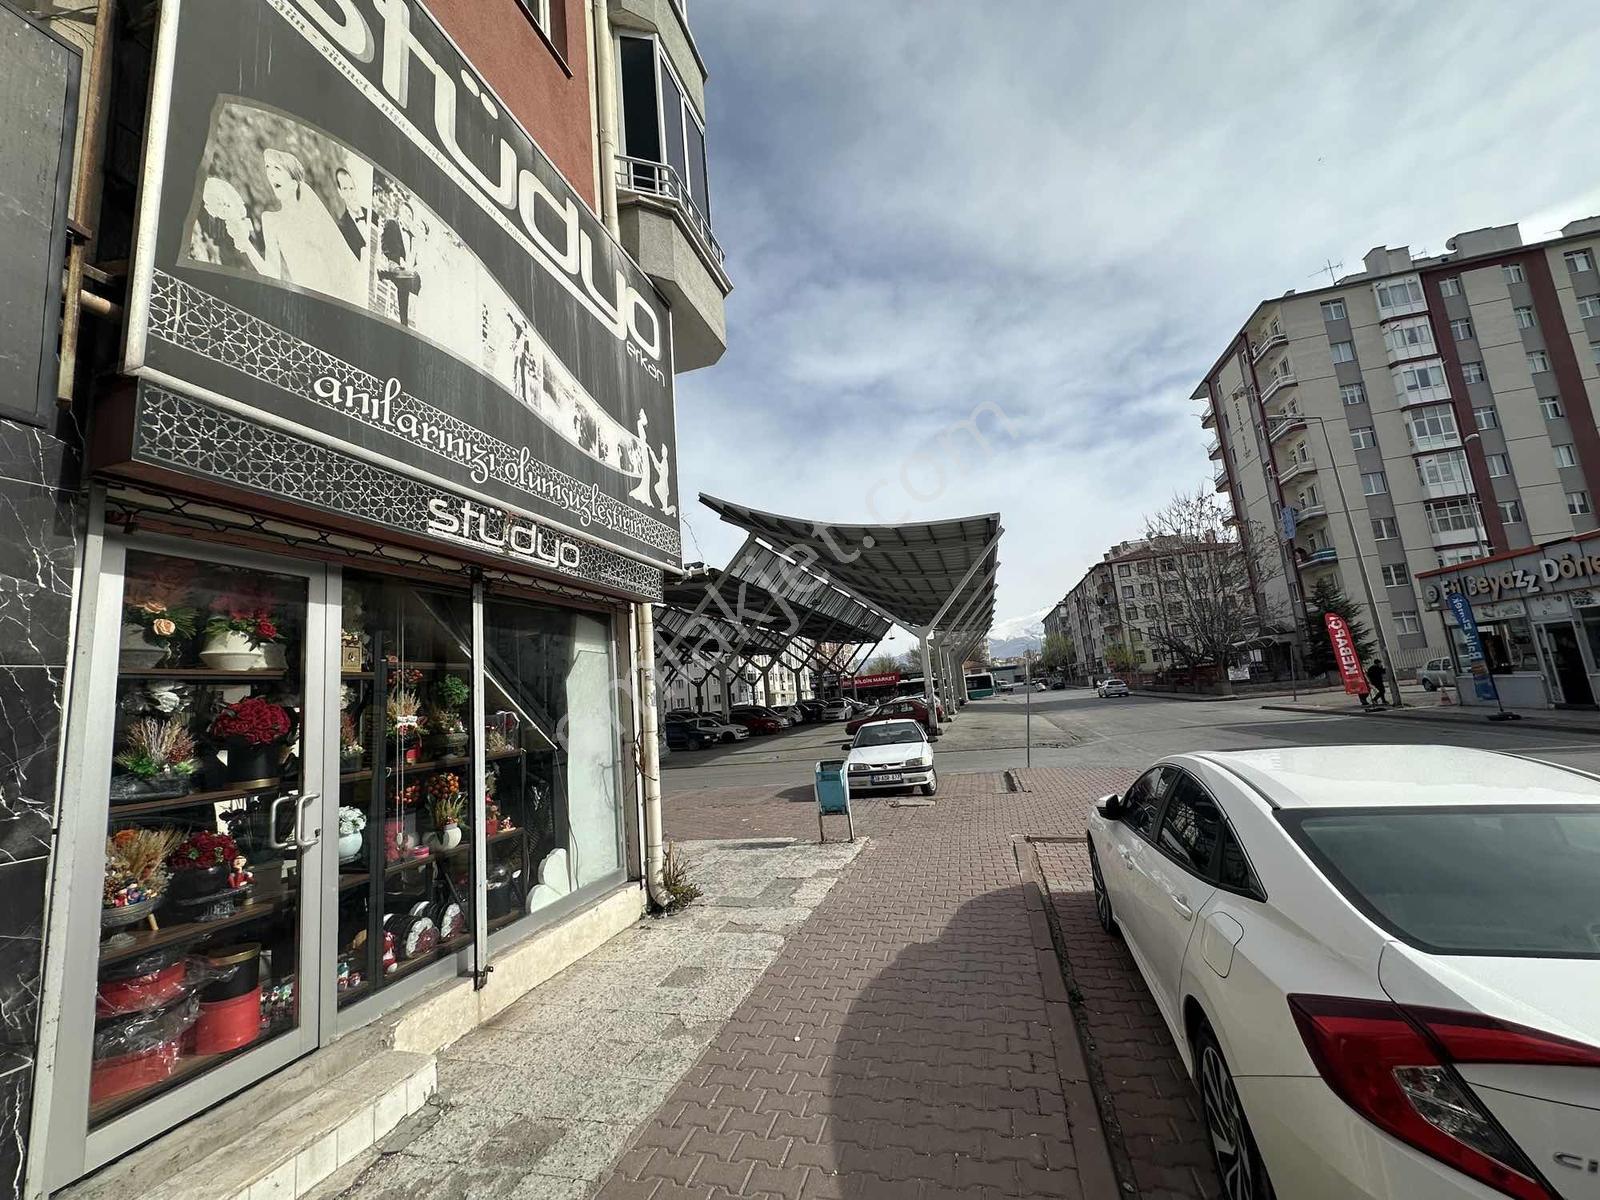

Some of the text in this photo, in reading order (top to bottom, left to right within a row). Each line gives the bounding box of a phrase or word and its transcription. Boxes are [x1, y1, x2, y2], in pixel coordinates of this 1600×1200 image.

[626, 340, 666, 387] erkan
[428, 499, 580, 568] stüdyo
[1465, 569, 1540, 600] Beyazz
